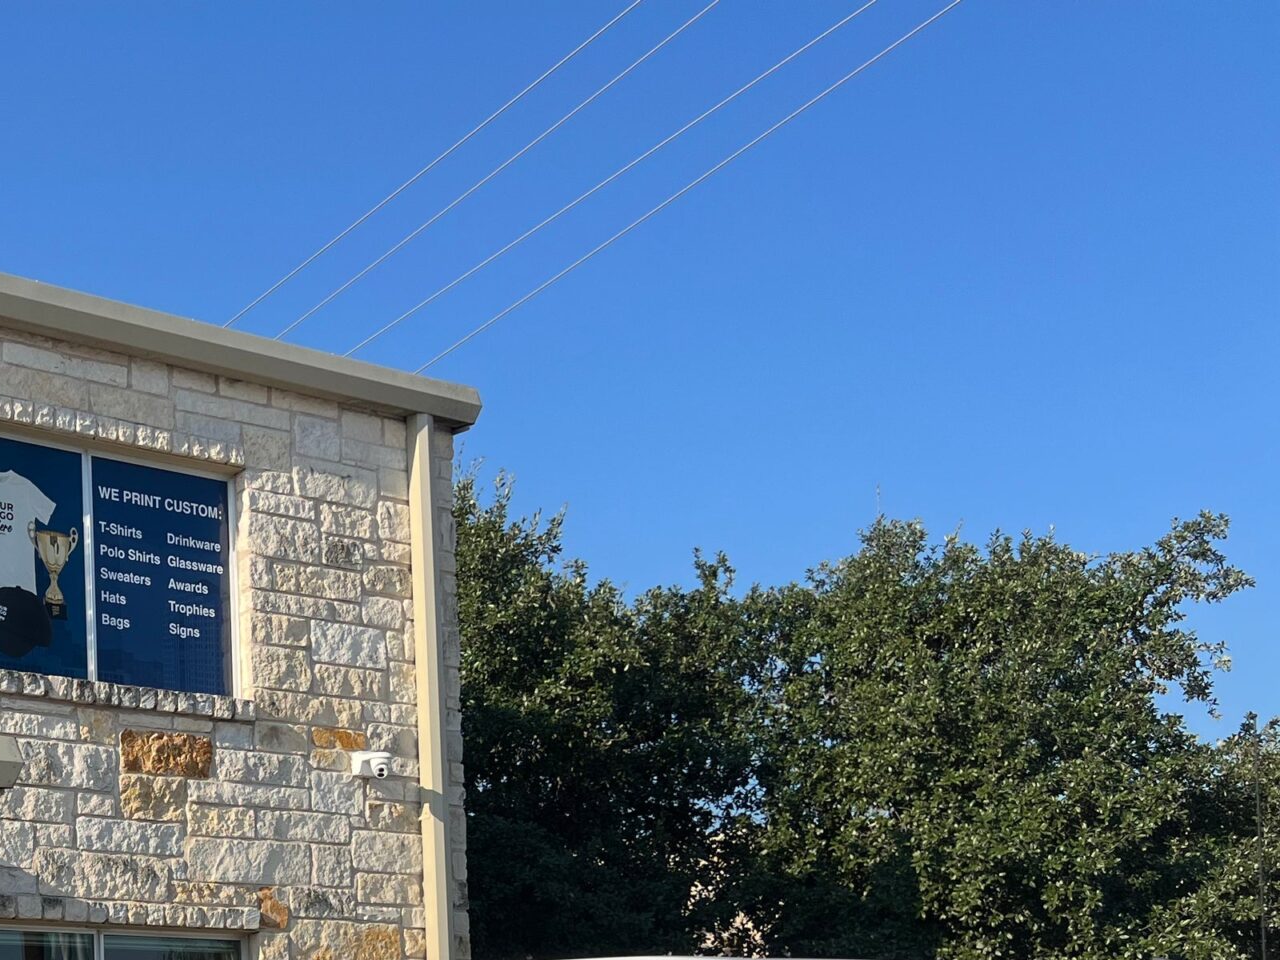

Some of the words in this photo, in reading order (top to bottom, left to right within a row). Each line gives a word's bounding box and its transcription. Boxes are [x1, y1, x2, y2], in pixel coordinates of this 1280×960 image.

[98, 485, 120, 502] WE
[123, 490, 162, 509] PRINT
[164, 498, 222, 520] CUSTOM:
[99, 521, 143, 540] T-Shirts
[167, 533, 221, 552] Drinkware
[100, 544, 126, 559] Polo
[128, 548, 161, 565] Shirts
[167, 556, 224, 575] Glassware
[100, 567, 151, 586] Sweaters
[168, 578, 209, 595] Awards
[101, 590, 127, 605] Hats
[168, 600, 216, 618] Trophies
[101, 613, 130, 630] Bags
[168, 623, 200, 639] Signs
